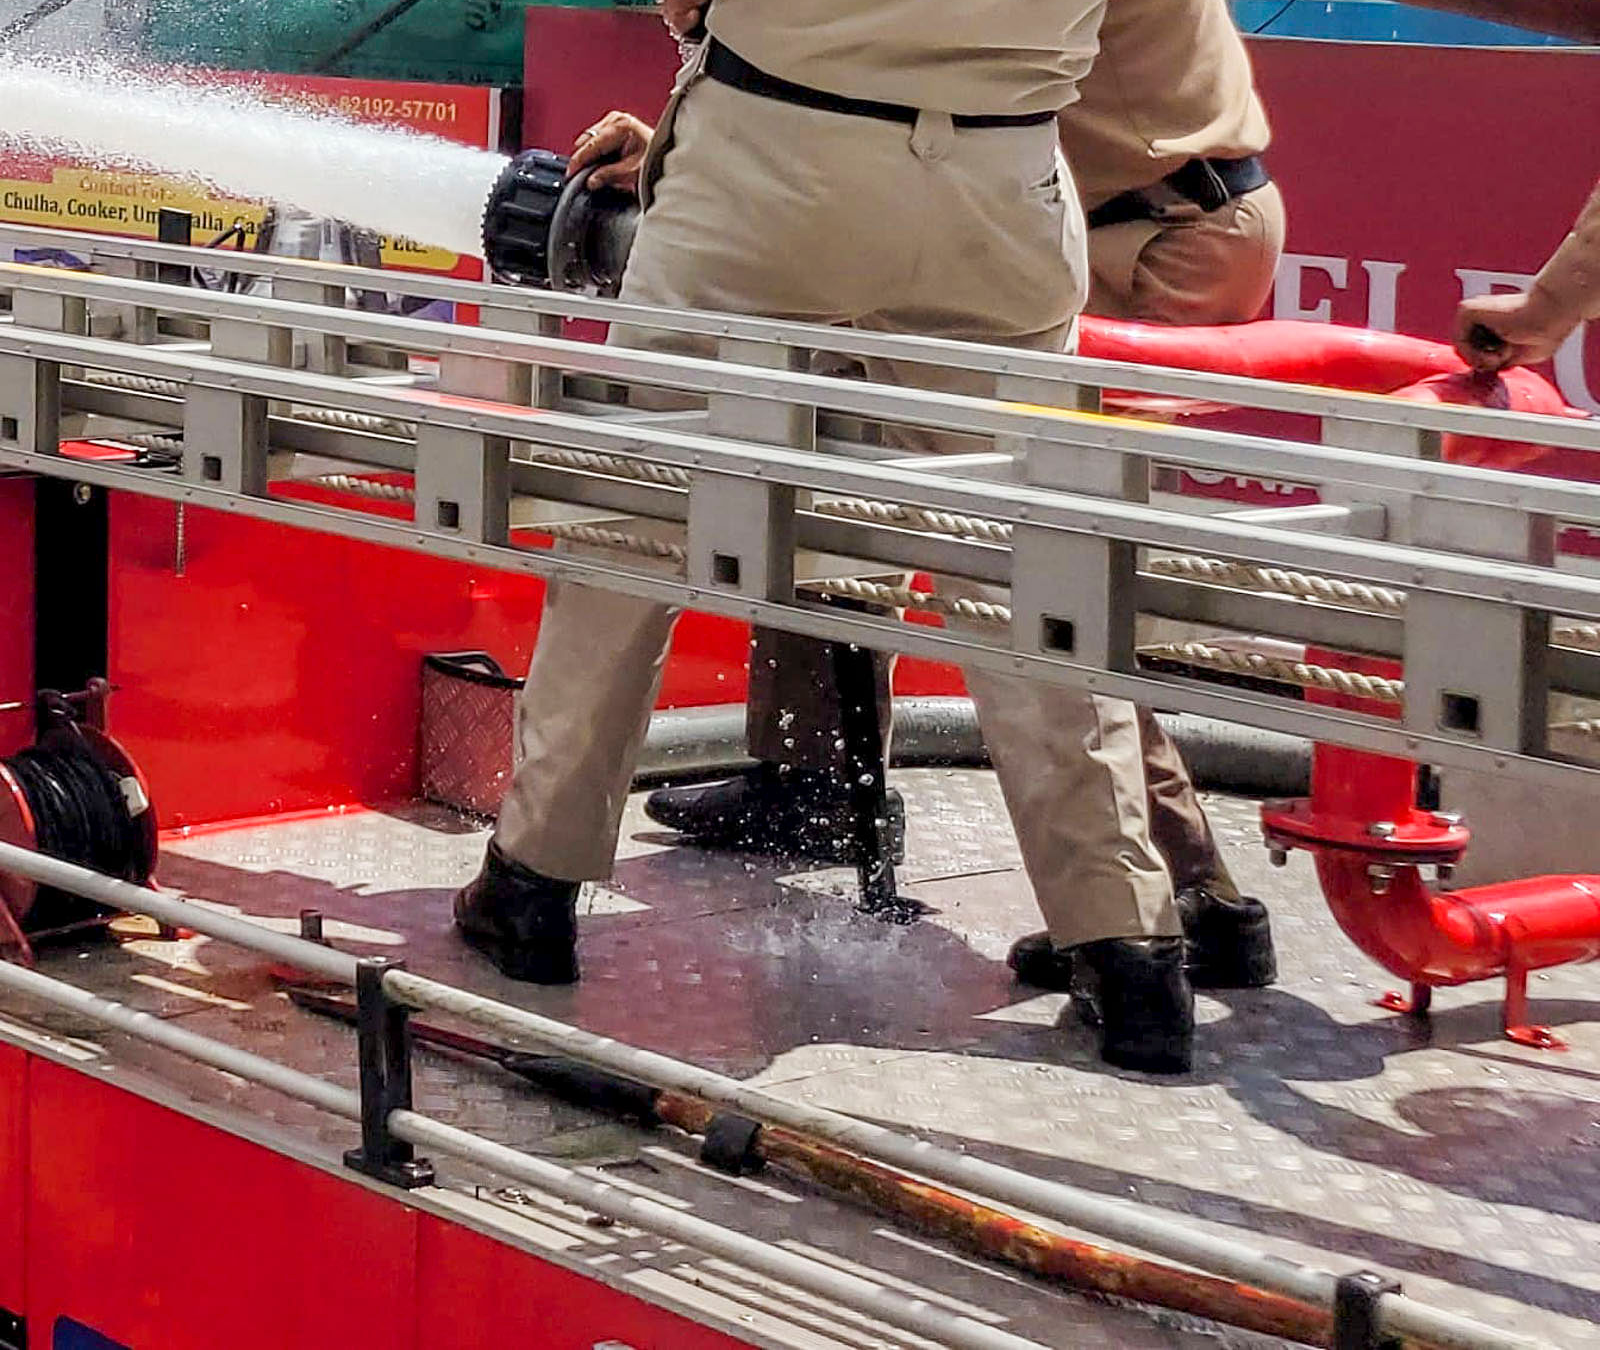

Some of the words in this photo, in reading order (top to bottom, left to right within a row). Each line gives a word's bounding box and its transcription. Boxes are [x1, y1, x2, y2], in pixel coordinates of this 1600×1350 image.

[337, 95, 458, 123] 82192-57701
[3, 191, 64, 217] Chulha,
[67, 198, 129, 223] Cooker,
